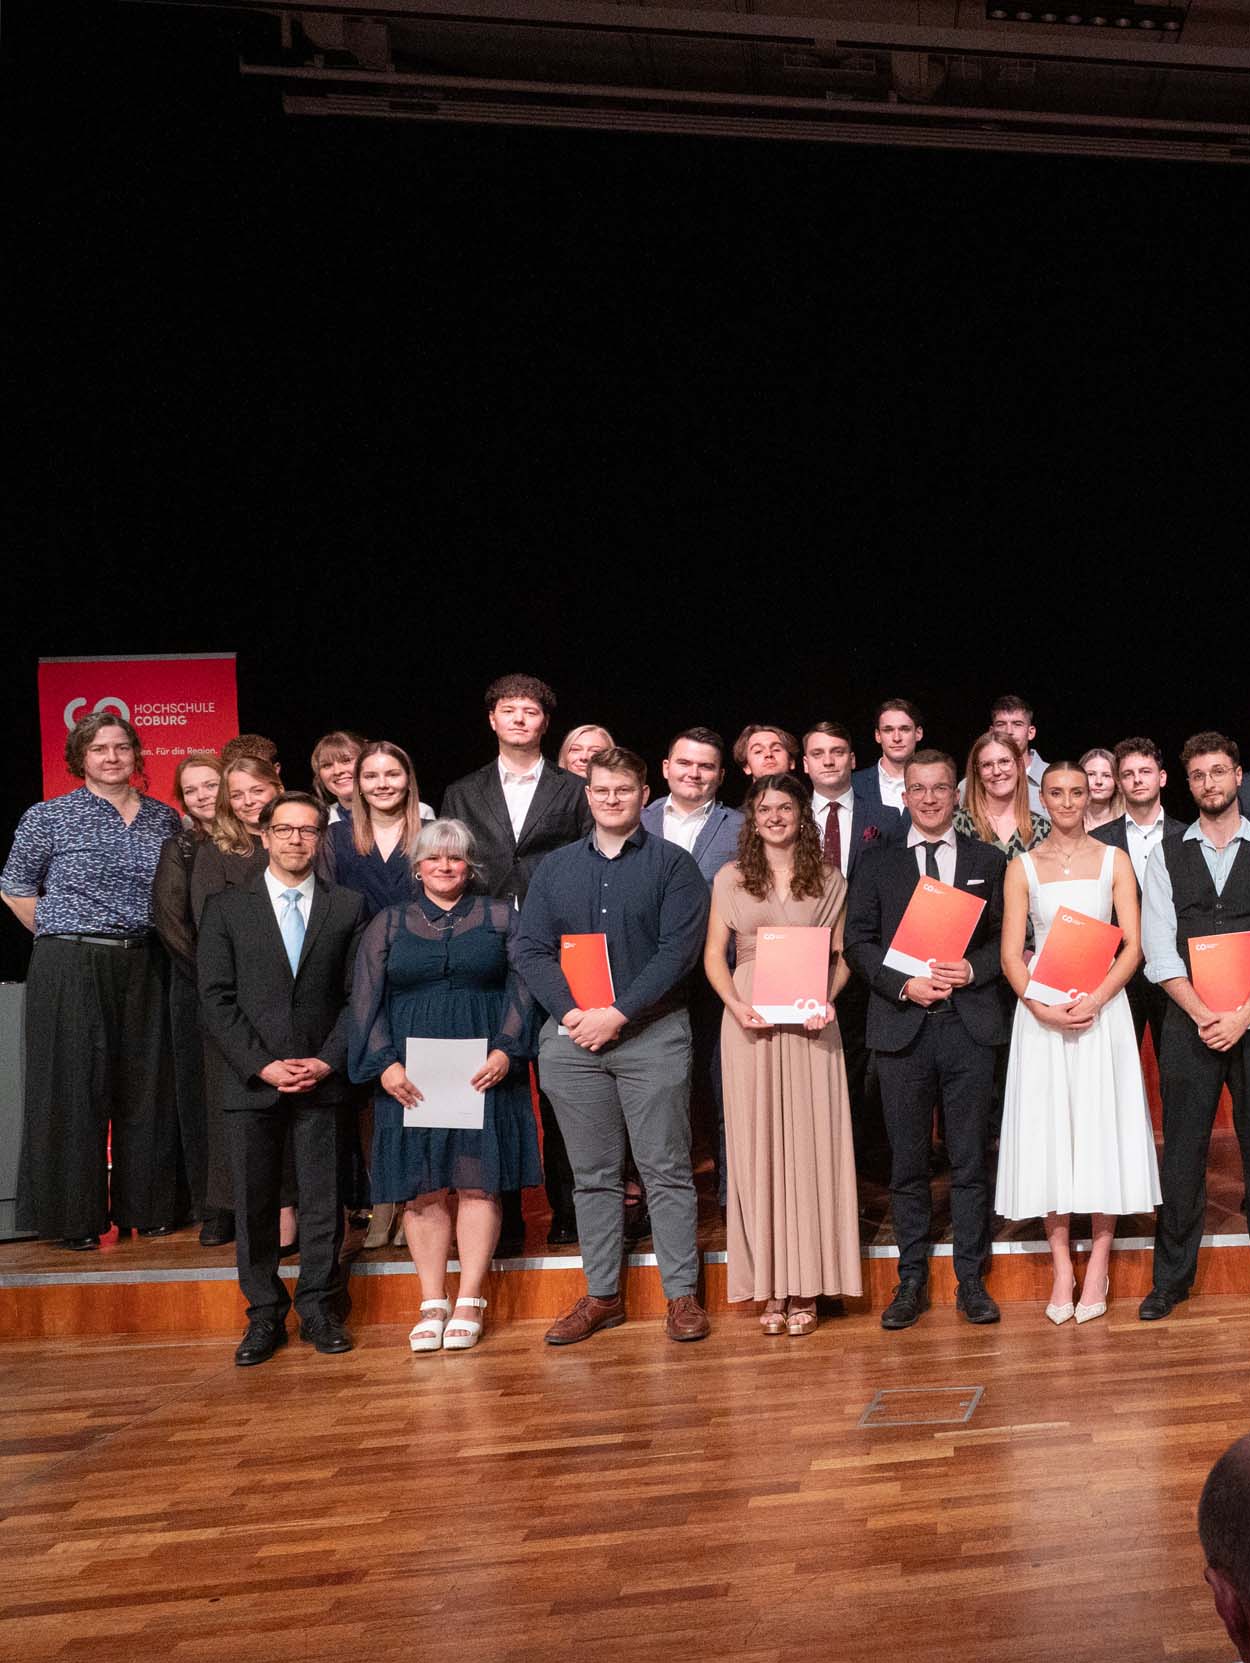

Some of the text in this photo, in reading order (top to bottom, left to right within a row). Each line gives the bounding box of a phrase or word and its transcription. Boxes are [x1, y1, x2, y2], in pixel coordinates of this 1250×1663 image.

[134, 702, 215, 714] HOCHSCHULE
[134, 715, 187, 726] COBURG
[156, 747, 169, 755] Für
[171, 747, 185, 755] die
